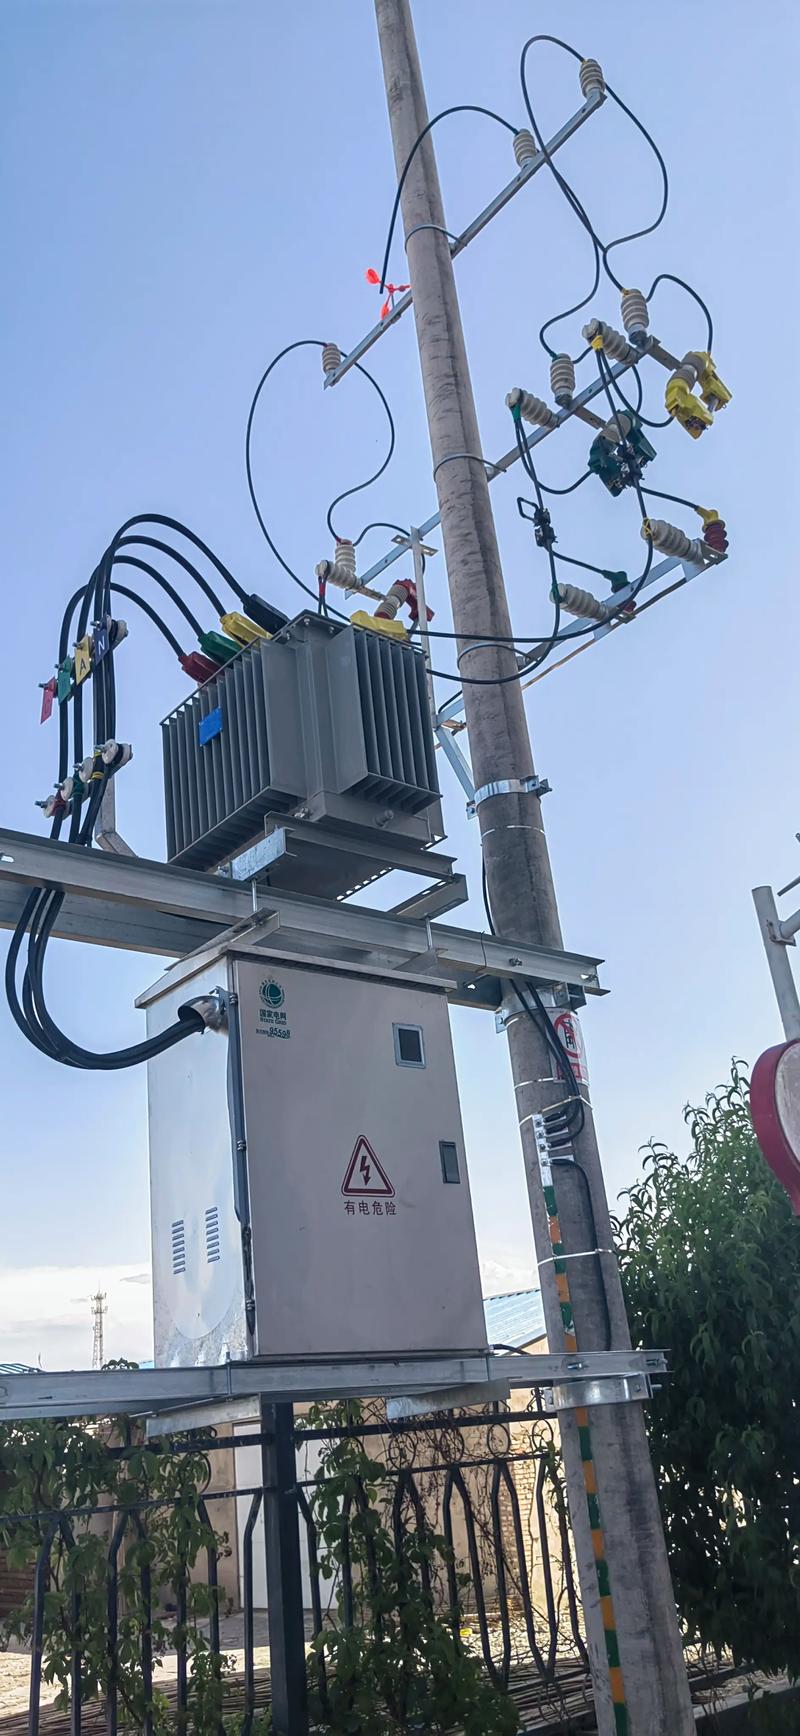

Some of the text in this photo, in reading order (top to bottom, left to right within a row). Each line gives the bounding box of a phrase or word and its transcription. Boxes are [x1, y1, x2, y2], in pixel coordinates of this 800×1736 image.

[97, 635, 106, 655] N
[79, 658, 87, 676] A
[259, 1008, 287, 1020] 国家电网
[269, 1026, 291, 1040] 95598
[343, 1200, 397, 1216] 有电危险
